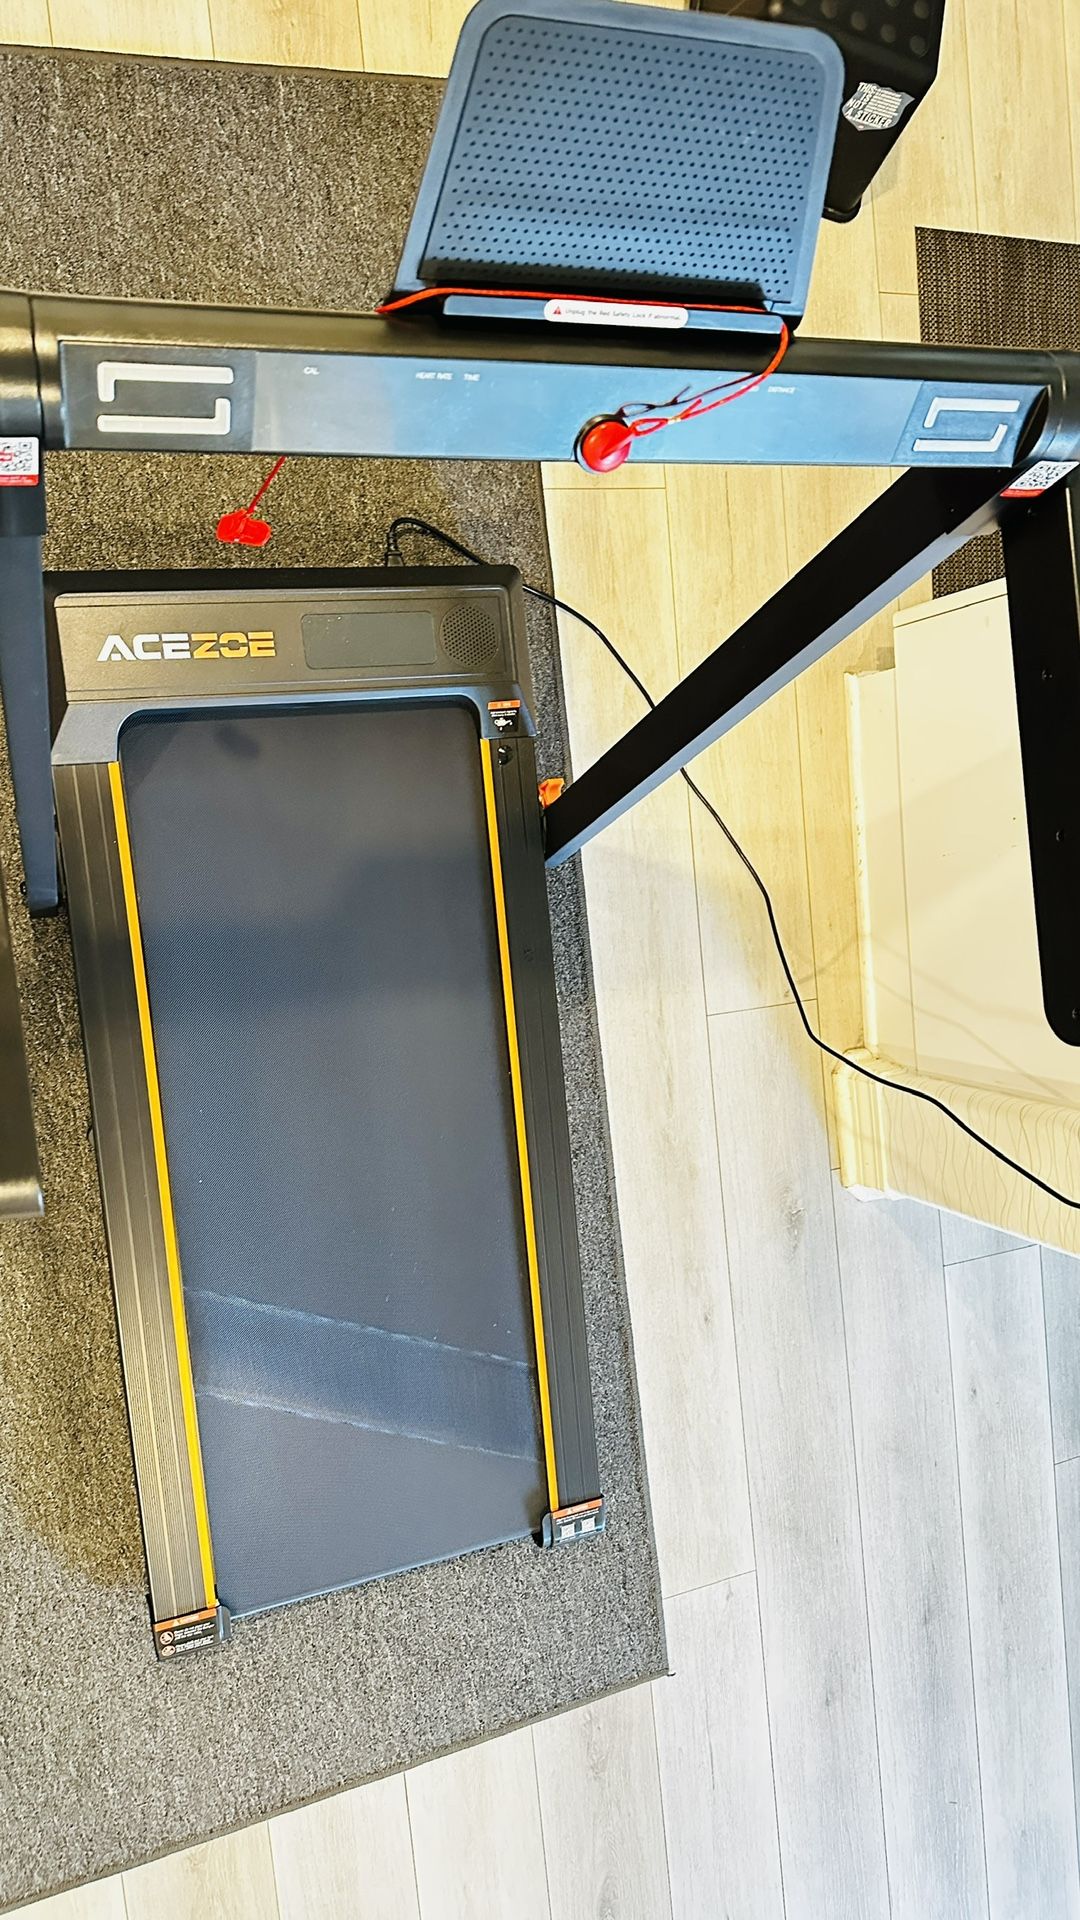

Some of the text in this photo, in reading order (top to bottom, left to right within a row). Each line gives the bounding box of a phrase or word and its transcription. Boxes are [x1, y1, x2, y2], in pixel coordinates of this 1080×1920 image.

[857, 82, 876, 94] THIS
[860, 92, 872, 102] IS
[847, 98, 867, 109] NOT
[844, 107, 893, 127] A STICKER
[303, 366, 320, 375] CAL
[96, 631, 276, 662] ACEZOE
